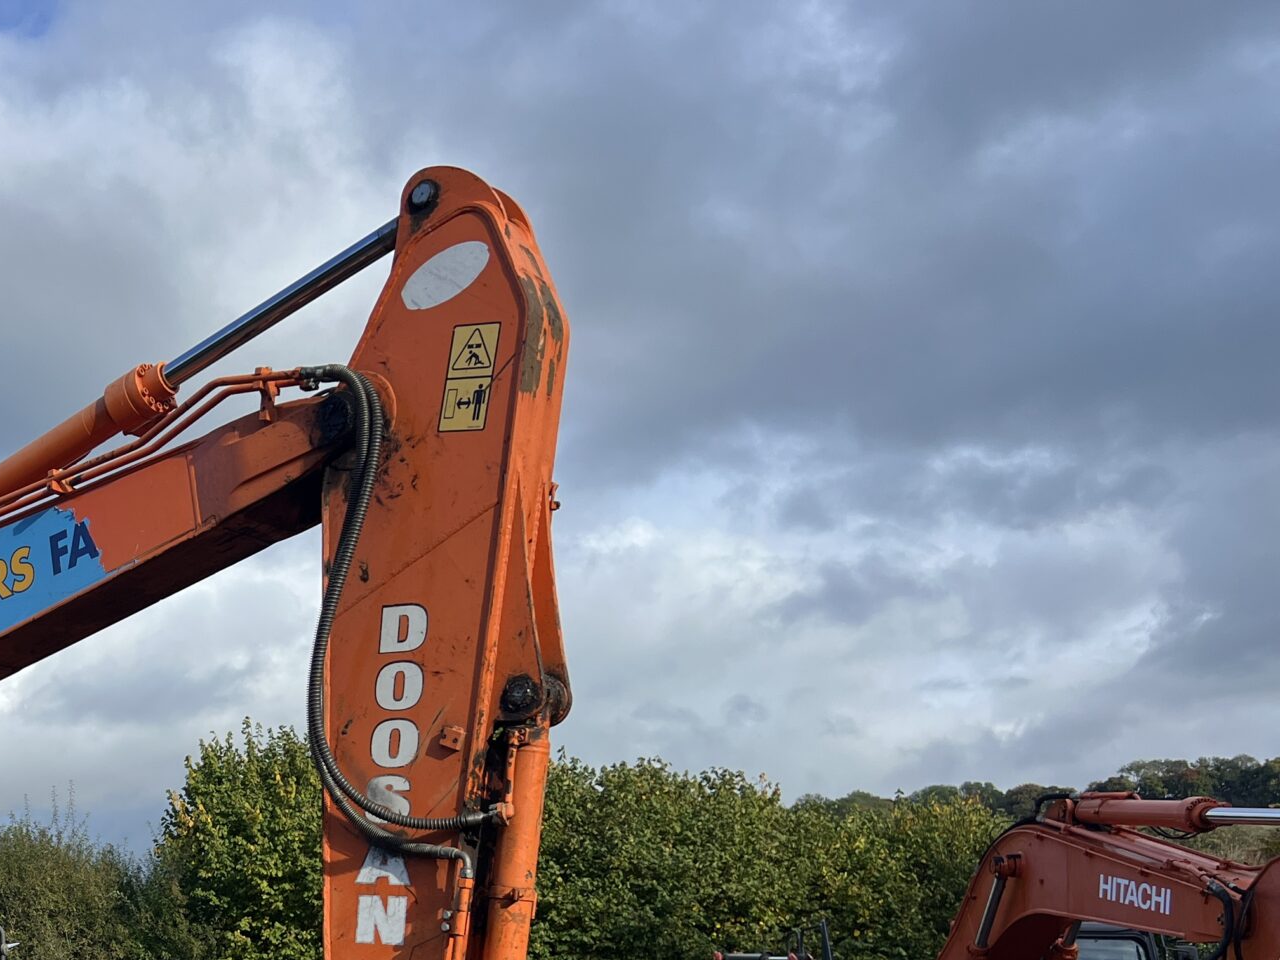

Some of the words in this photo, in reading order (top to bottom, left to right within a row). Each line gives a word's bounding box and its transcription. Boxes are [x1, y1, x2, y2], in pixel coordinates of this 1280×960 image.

[49, 520, 99, 576] FA
[355, 603, 428, 946] DOOSAN
[1099, 874, 1171, 915] HITACHI
